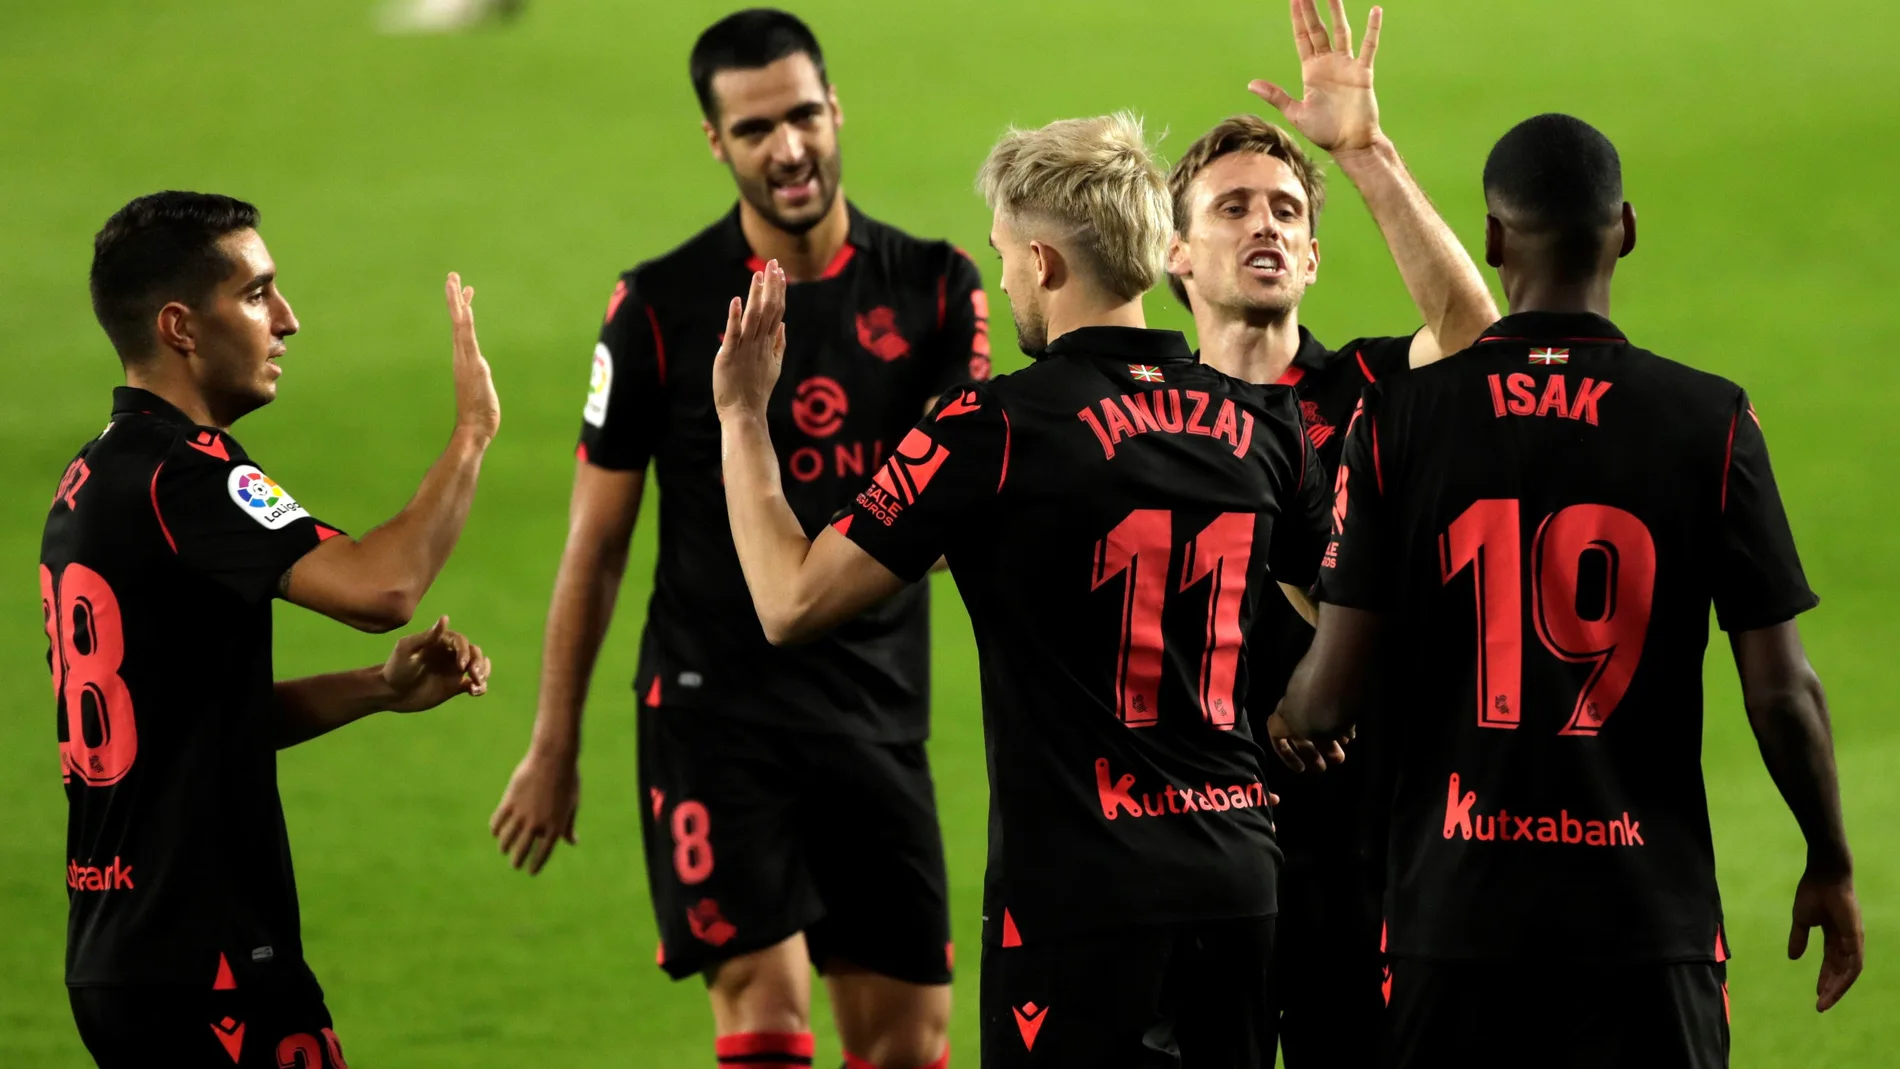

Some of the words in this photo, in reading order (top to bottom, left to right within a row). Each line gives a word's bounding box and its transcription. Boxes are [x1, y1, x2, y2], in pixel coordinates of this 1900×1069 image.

[1078, 389, 1254, 460] JANUZAJ
[1488, 373, 1612, 426] ISAK
[1091, 509, 1256, 730] 11
[1439, 499, 1656, 736] 19
[1095, 757, 1267, 820] Kutxaban
[1443, 772, 1644, 846] Kutxabank
[671, 800, 714, 884] 8
